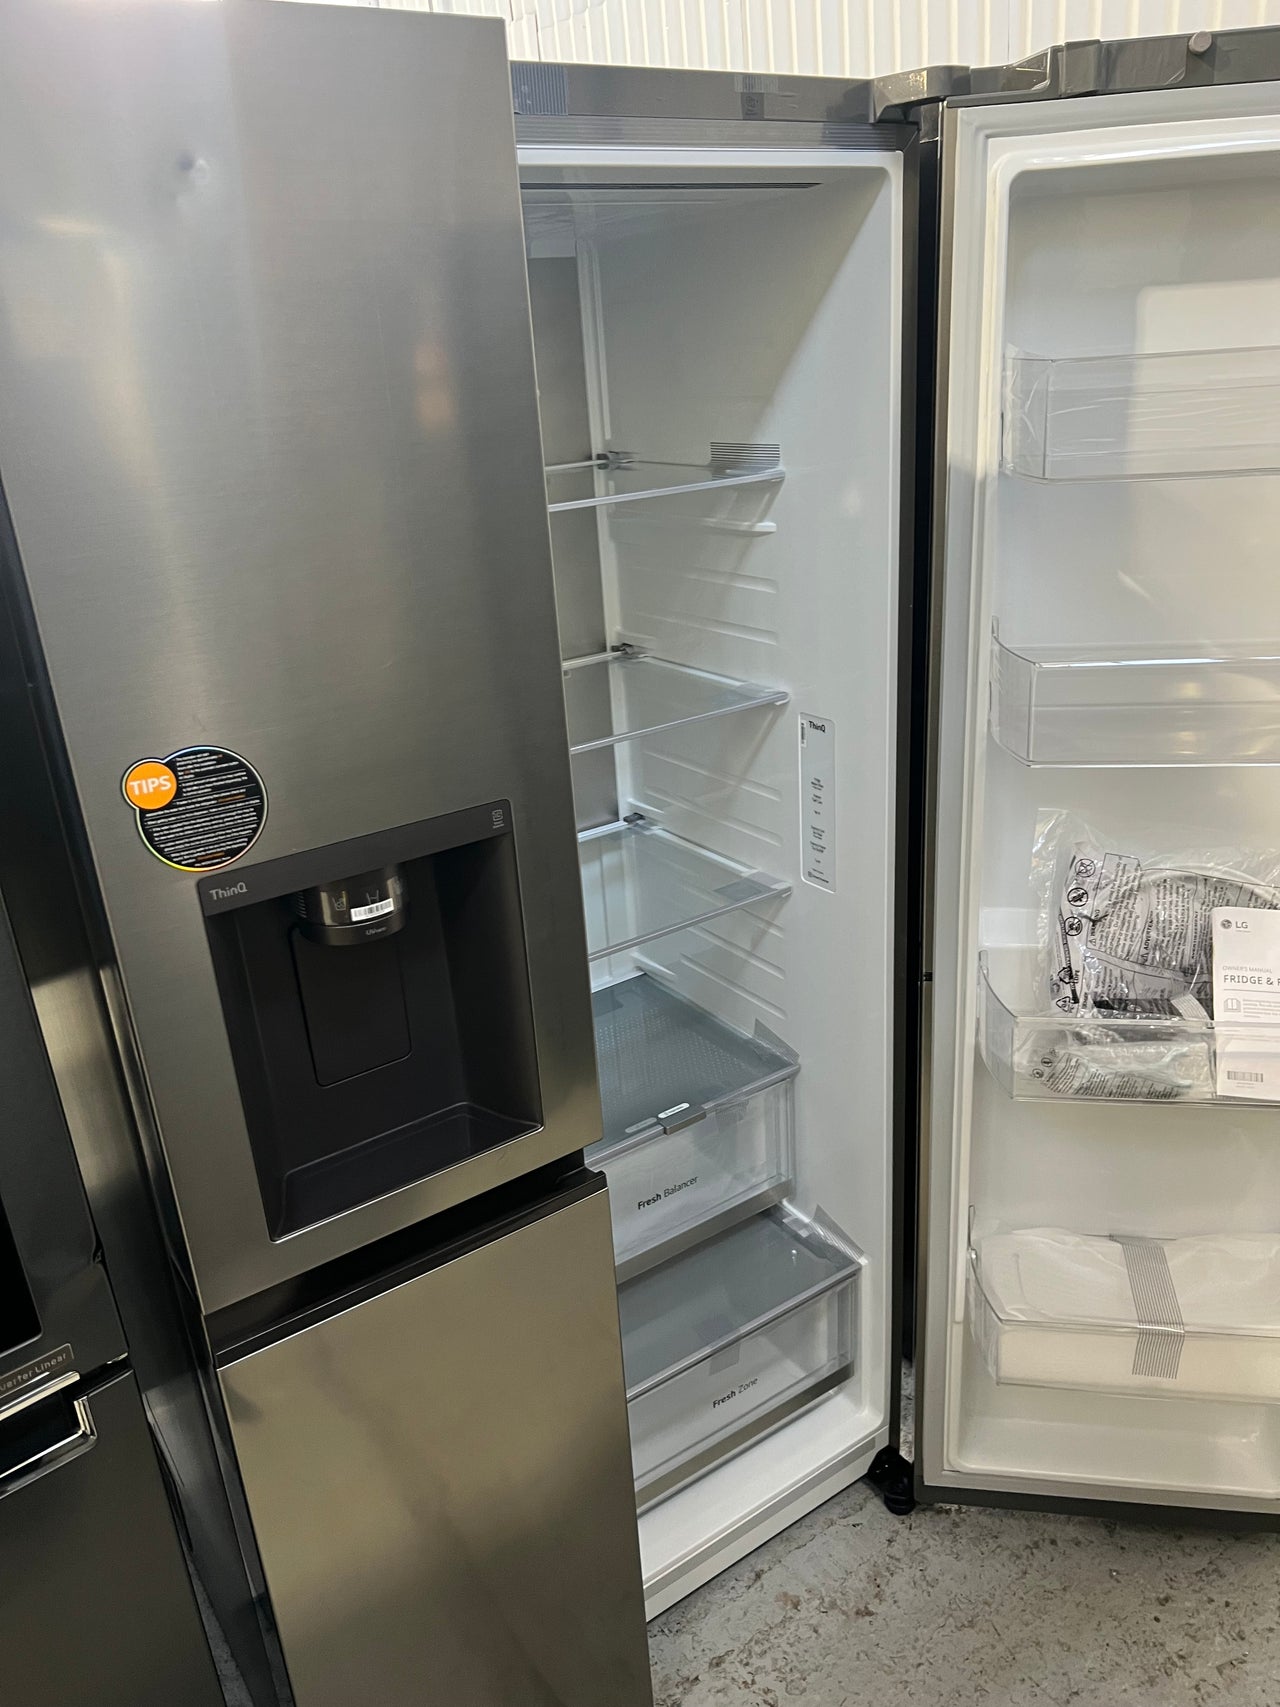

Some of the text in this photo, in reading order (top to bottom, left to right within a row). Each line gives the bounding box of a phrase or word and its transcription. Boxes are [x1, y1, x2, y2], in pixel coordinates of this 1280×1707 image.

[809, 720, 826, 734] ThinQ
[130, 774, 173, 796] TIPS
[209, 882, 247, 901] ThinQ
[1235, 921, 1249, 929] LG
[1223, 974, 1263, 985] FRIDGE
[1266, 977, 1274, 986] &
[637, 1175, 699, 1210] Fresh Balancer
[35, 1352, 67, 1373] Linear
[712, 1376, 759, 1409] Fresh Zone
